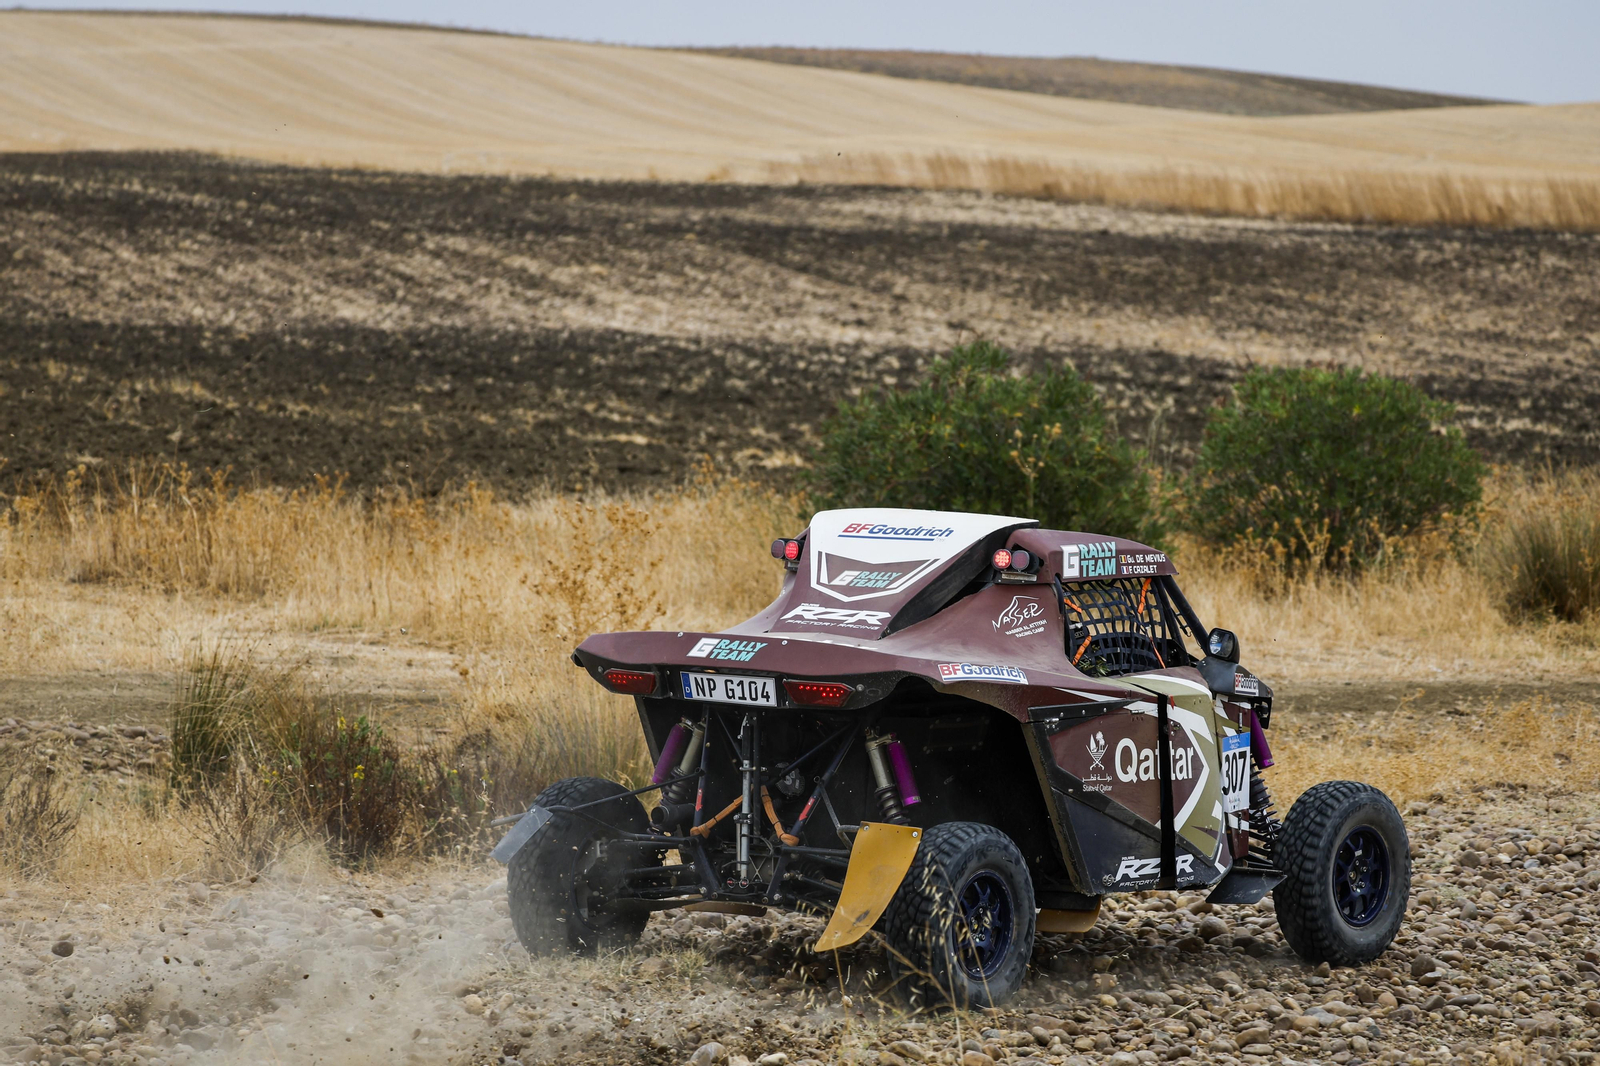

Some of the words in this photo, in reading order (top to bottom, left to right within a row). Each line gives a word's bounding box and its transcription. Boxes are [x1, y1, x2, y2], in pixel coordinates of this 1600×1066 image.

[842, 523, 954, 537] BFGoodrich
[1060, 544, 1080, 578] G
[1077, 541, 1116, 559] RALLY
[1136, 554, 1144, 562] DE
[856, 570, 902, 581] RALLY
[1081, 558, 1116, 577] TEAM
[849, 579, 891, 588] TEAM
[780, 605, 891, 625] RZR
[837, 623, 880, 631] RACING
[716, 639, 768, 652] RALLY
[710, 649, 755, 661] TEAM
[694, 677, 716, 697] NP
[724, 679, 770, 702] G104
[1115, 738, 1194, 783] Qatar
[1222, 750, 1247, 796] 307
[1113, 854, 1195, 883] RZR
